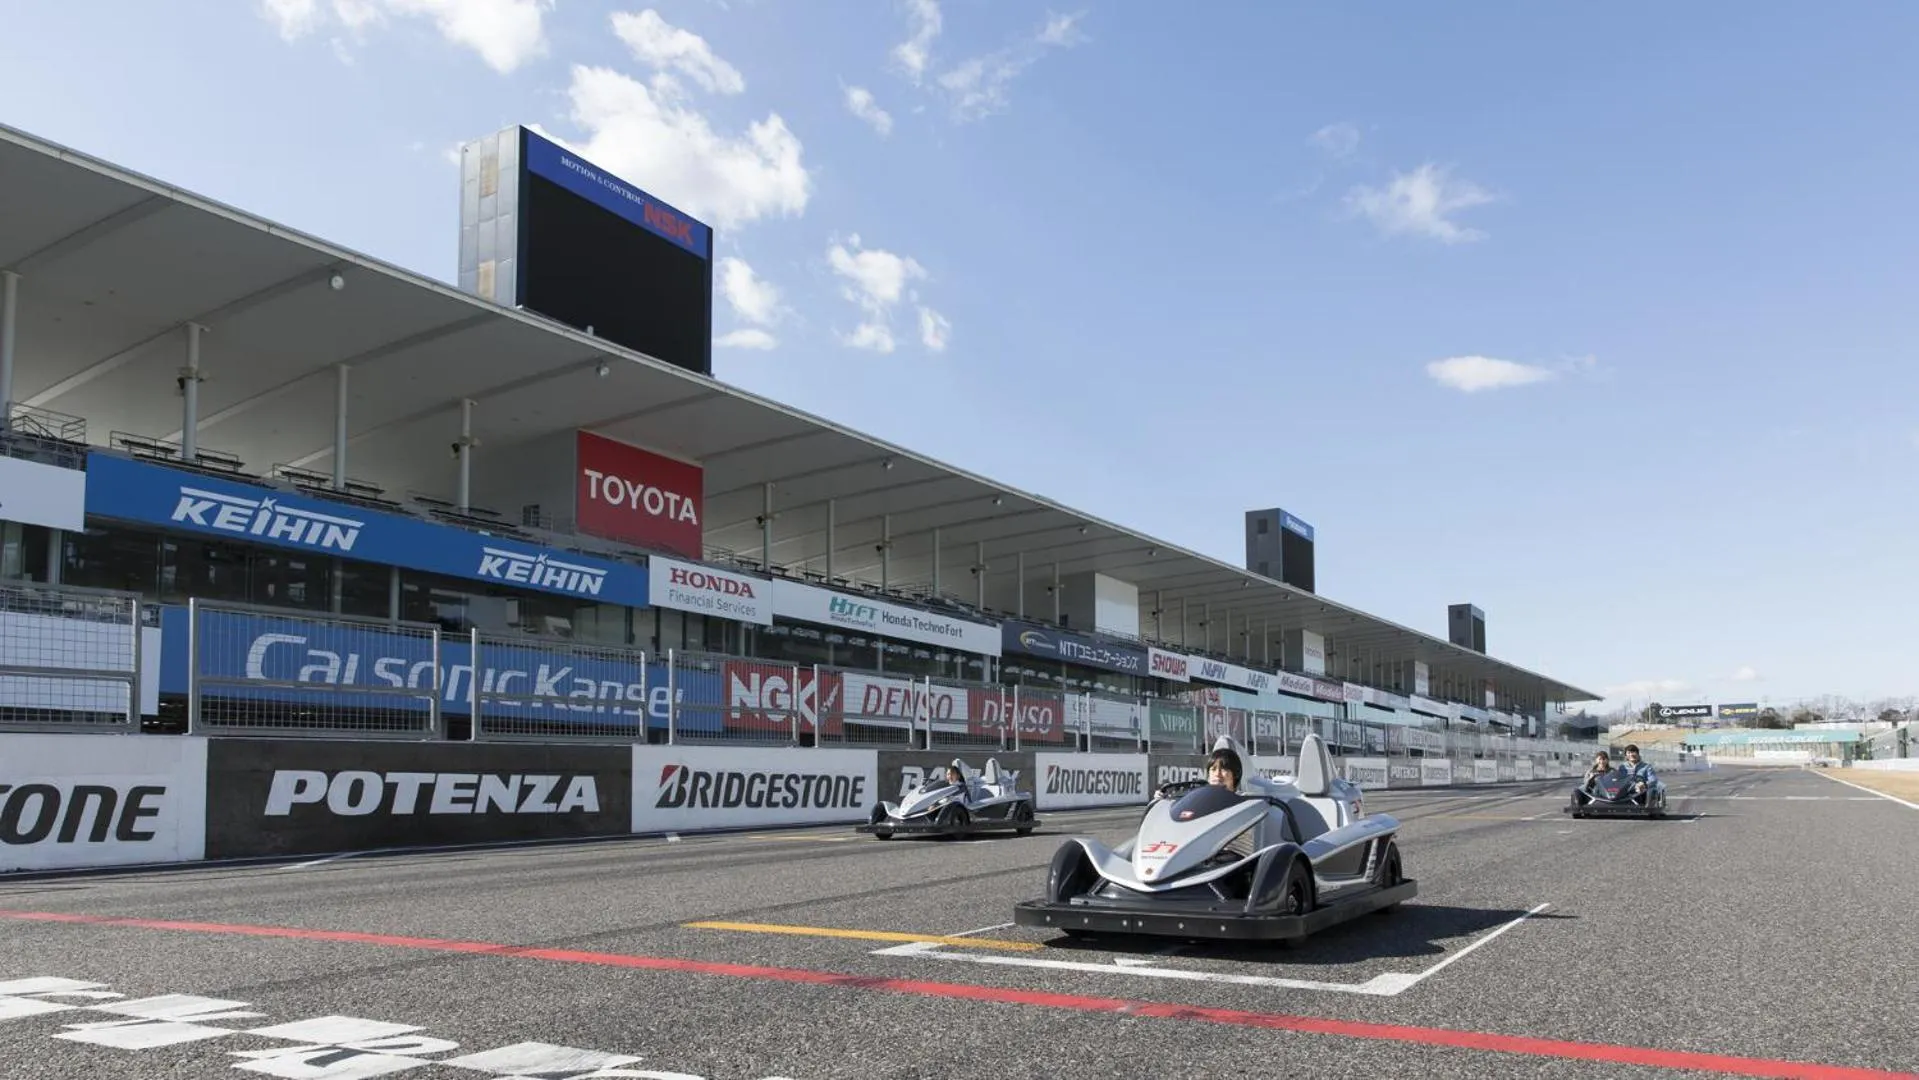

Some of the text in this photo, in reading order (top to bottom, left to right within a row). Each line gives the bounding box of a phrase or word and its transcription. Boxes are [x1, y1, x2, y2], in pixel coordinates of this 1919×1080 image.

[561, 155, 596, 181] MOTION
[644, 203, 694, 246] NSK
[584, 468, 698, 525] TOYOTA
[172, 489, 365, 551] KEIHIN
[477, 550, 607, 595] KEIHIN
[670, 567, 756, 599] HONDA
[669, 588, 757, 618] Financial Services
[882, 610, 912, 628] Honda
[1151, 653, 1188, 677] SHOWA
[731, 671, 817, 727] NGK
[863, 683, 953, 722] DENSO
[982, 699, 1053, 735] DENSO
[264, 770, 600, 816] POTENZA
[655, 764, 866, 809] BRIDGESTONE
[1045, 765, 1142, 795] BRIDGESTONE
